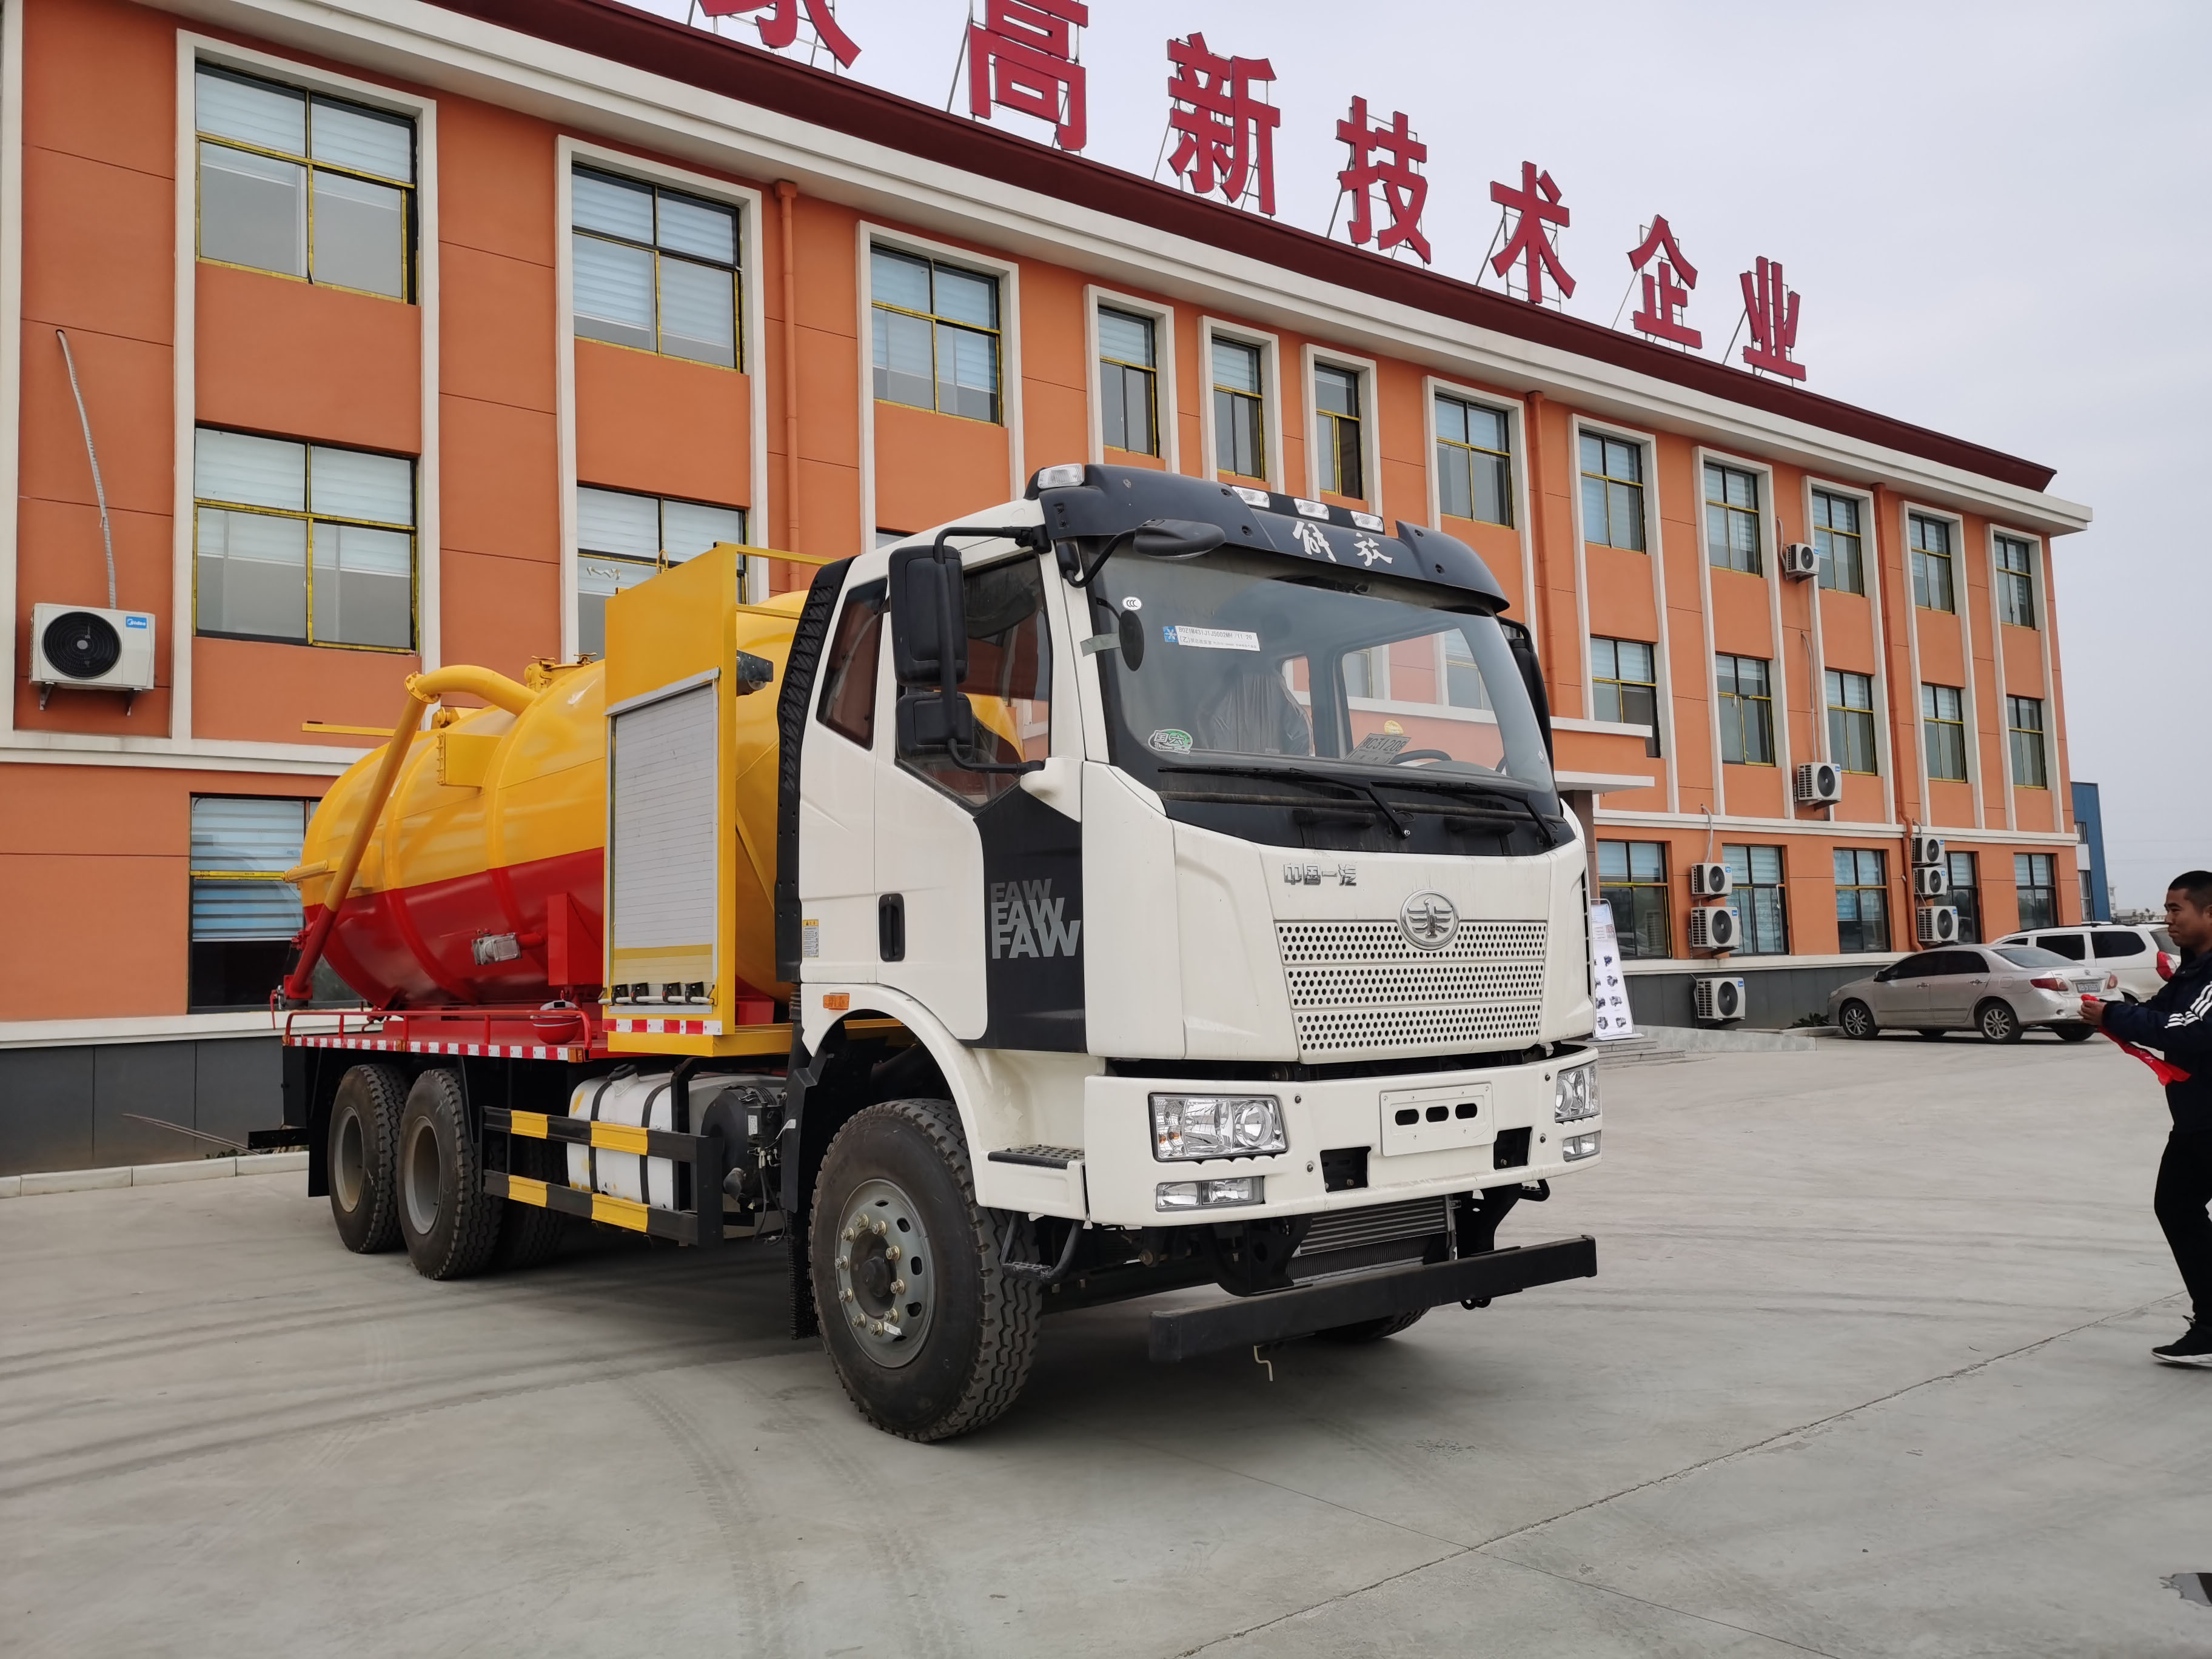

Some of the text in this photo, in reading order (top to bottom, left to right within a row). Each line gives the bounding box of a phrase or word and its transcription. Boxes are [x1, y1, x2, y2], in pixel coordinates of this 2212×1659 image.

[1154, 732, 1185, 746] 国六
[1284, 863, 1357, 886] 中国一汽
[990, 879, 1052, 905] FAW
[991, 897, 1065, 929] FAW
[992, 919, 1081, 959] FAW
